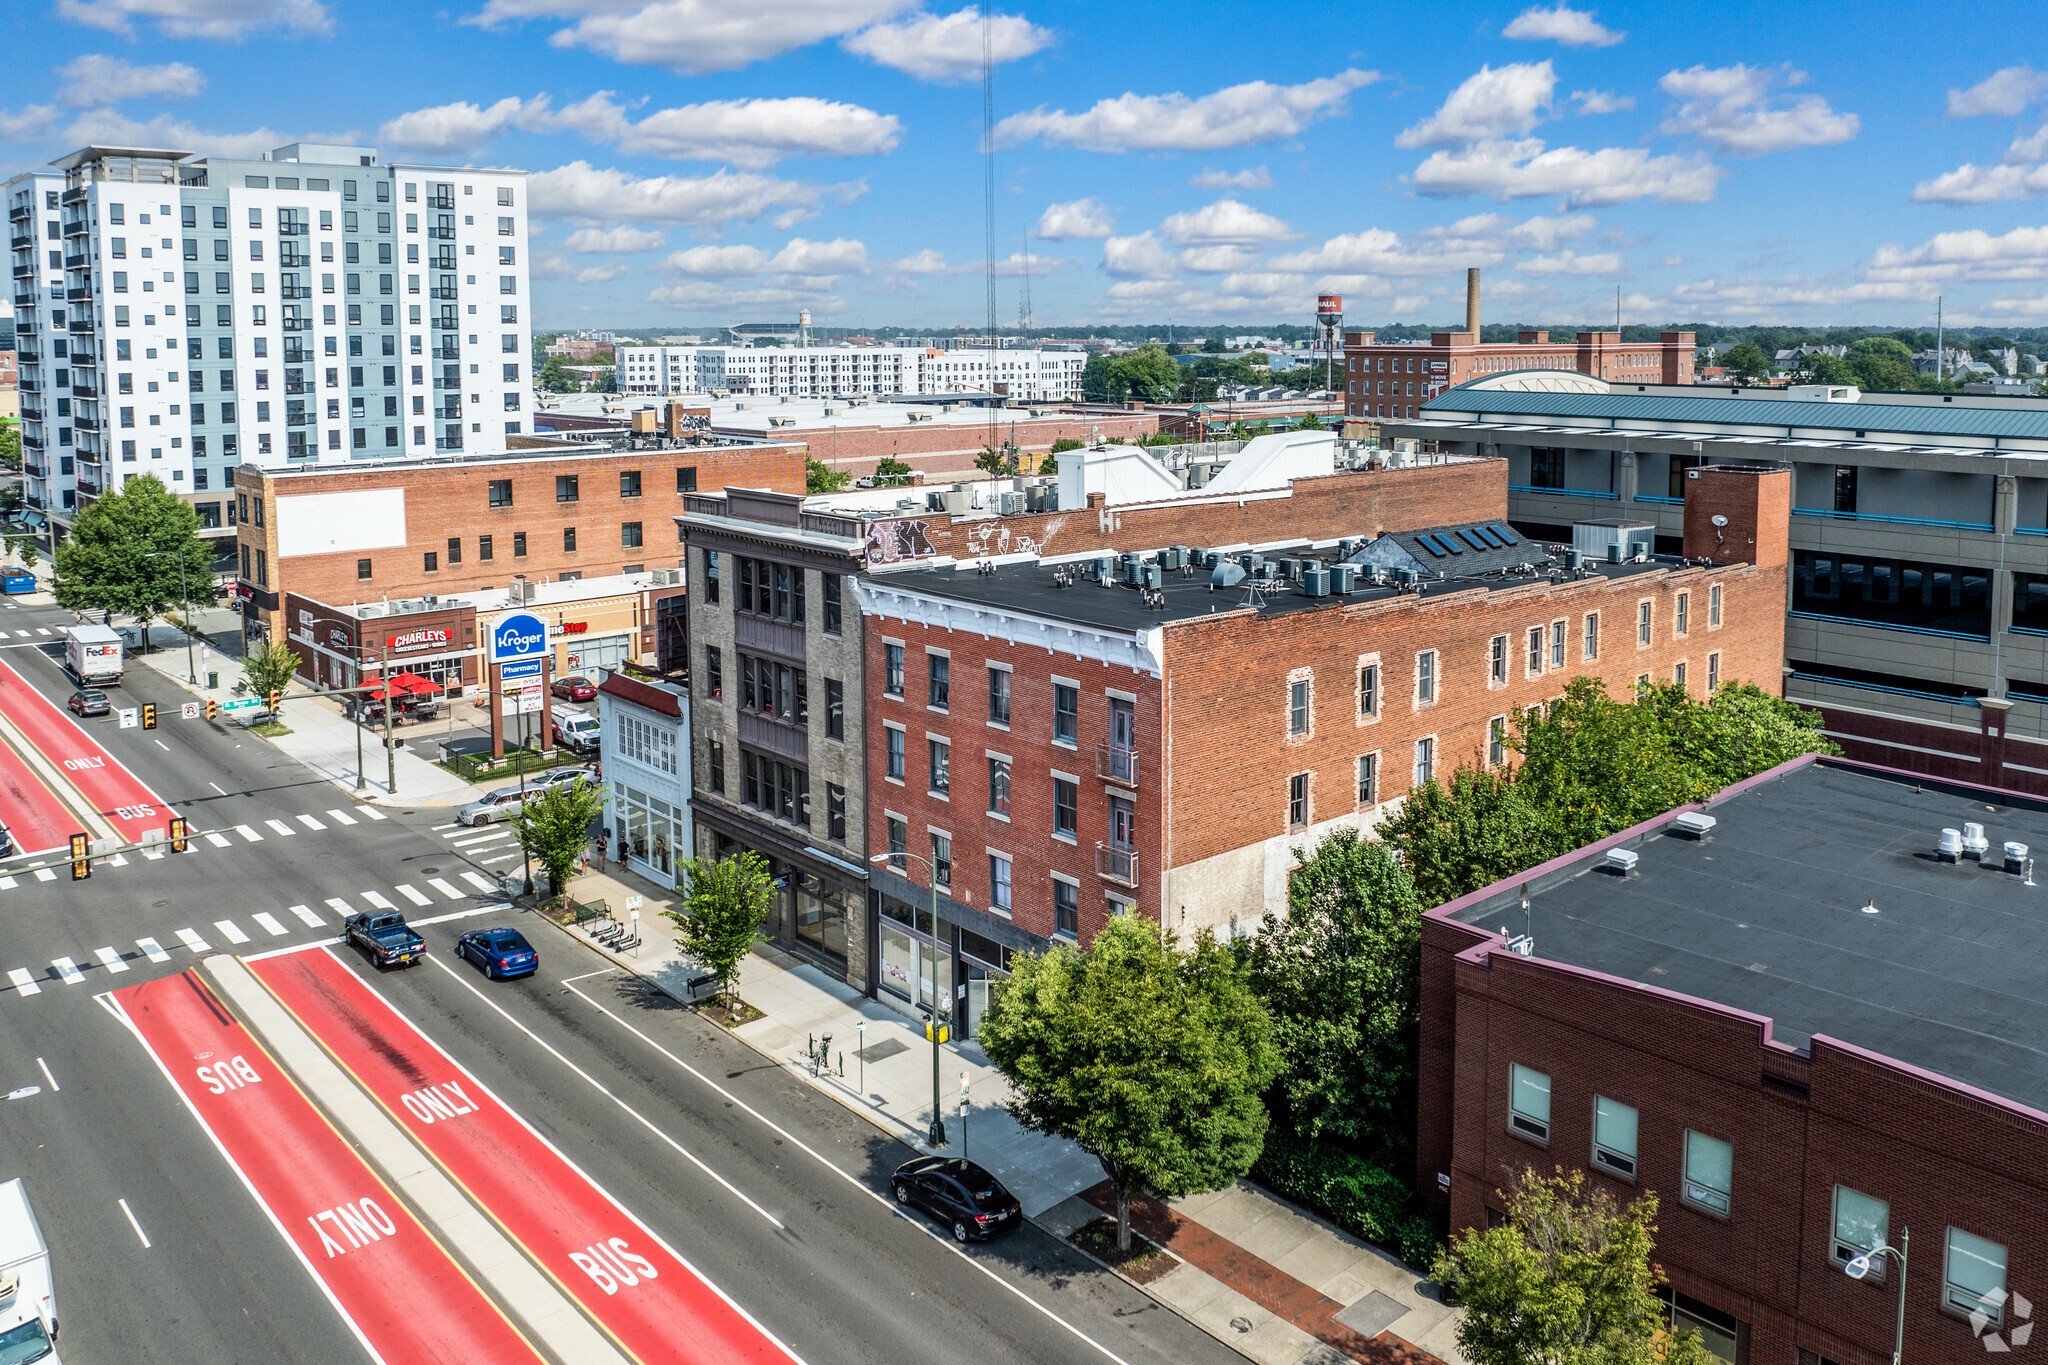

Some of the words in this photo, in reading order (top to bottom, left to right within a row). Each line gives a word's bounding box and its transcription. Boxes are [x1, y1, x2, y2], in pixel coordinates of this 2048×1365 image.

[1099, 509, 1121, 534] Hi
[395, 630, 447, 648] CHARLEYS
[549, 622, 588, 635] meStop
[86, 645, 118, 657] FedEx
[498, 629, 543, 653] Kroger
[503, 664, 539, 674] Pharmacy
[63, 756, 106, 771] ONLY
[114, 803, 157, 820] BUS
[196, 1055, 262, 1096] BUS
[400, 1080, 481, 1124] ONLY
[307, 1197, 397, 1259] ONLY
[568, 1237, 659, 1296] BUS
